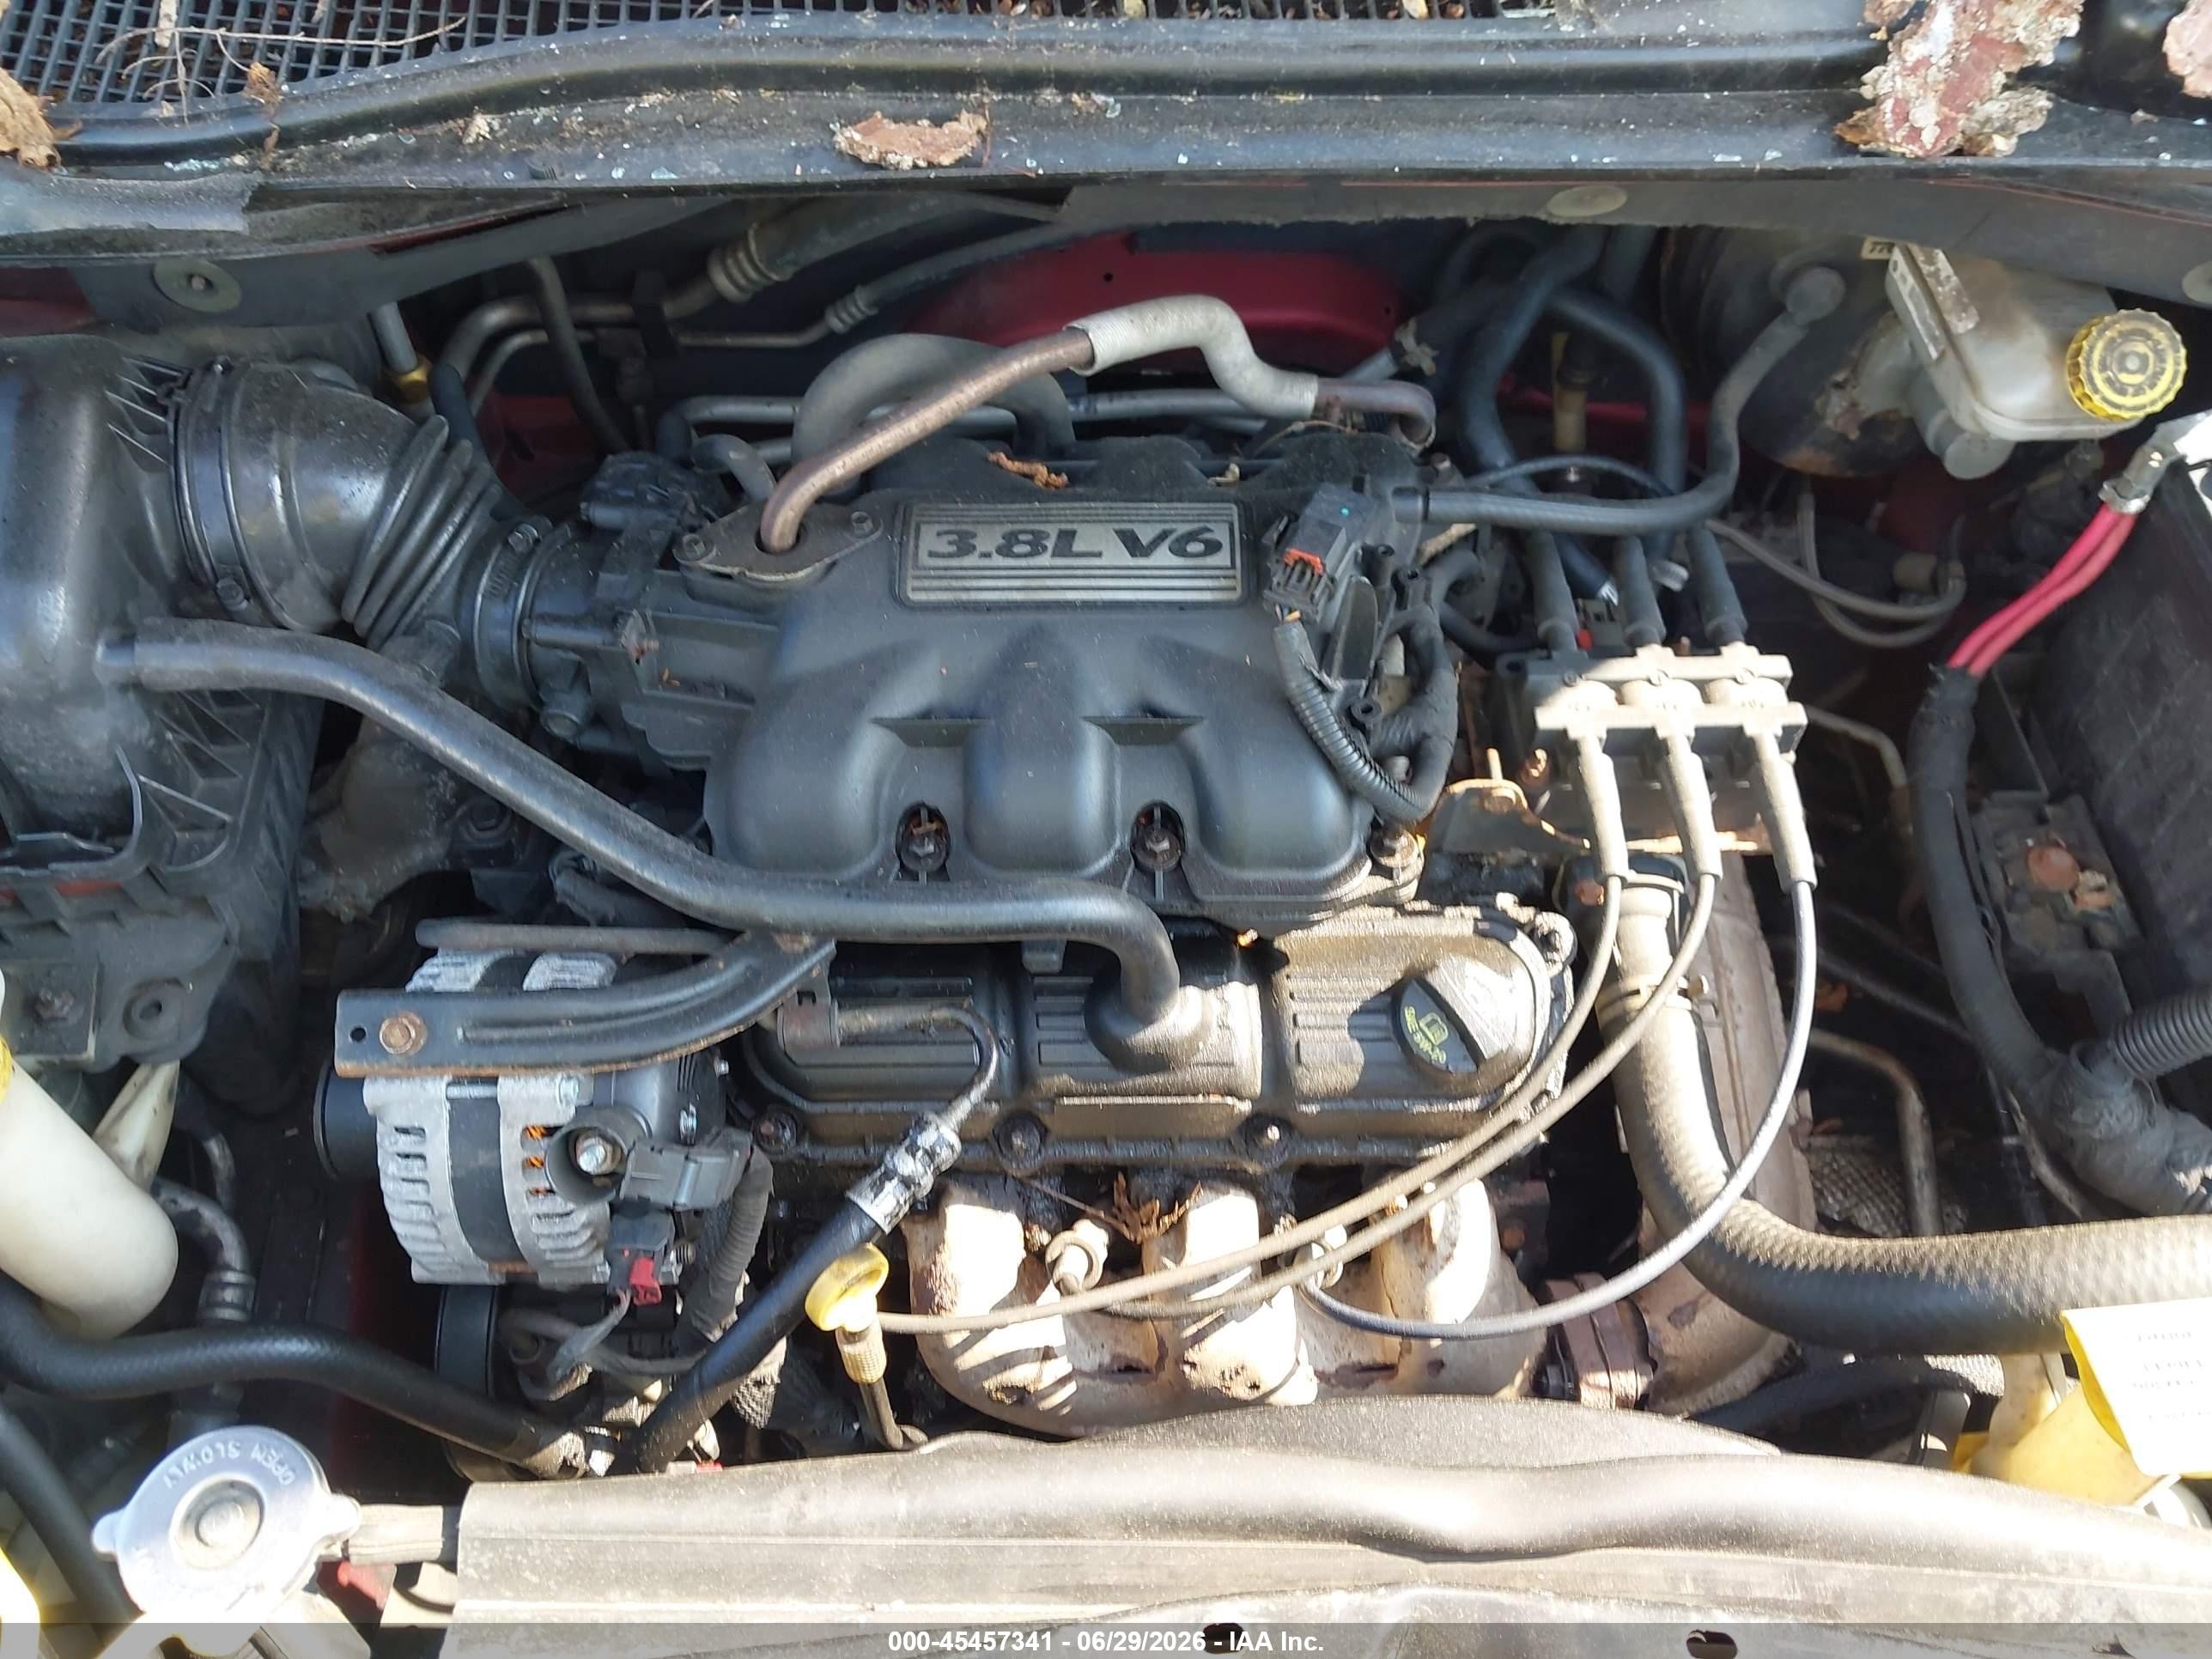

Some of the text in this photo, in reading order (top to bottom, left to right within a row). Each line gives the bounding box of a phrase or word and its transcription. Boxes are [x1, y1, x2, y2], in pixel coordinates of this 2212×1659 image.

[928, 526, 1223, 558] 3.8L V6
[163, 1440, 296, 1489] OPEN SLOWLY
